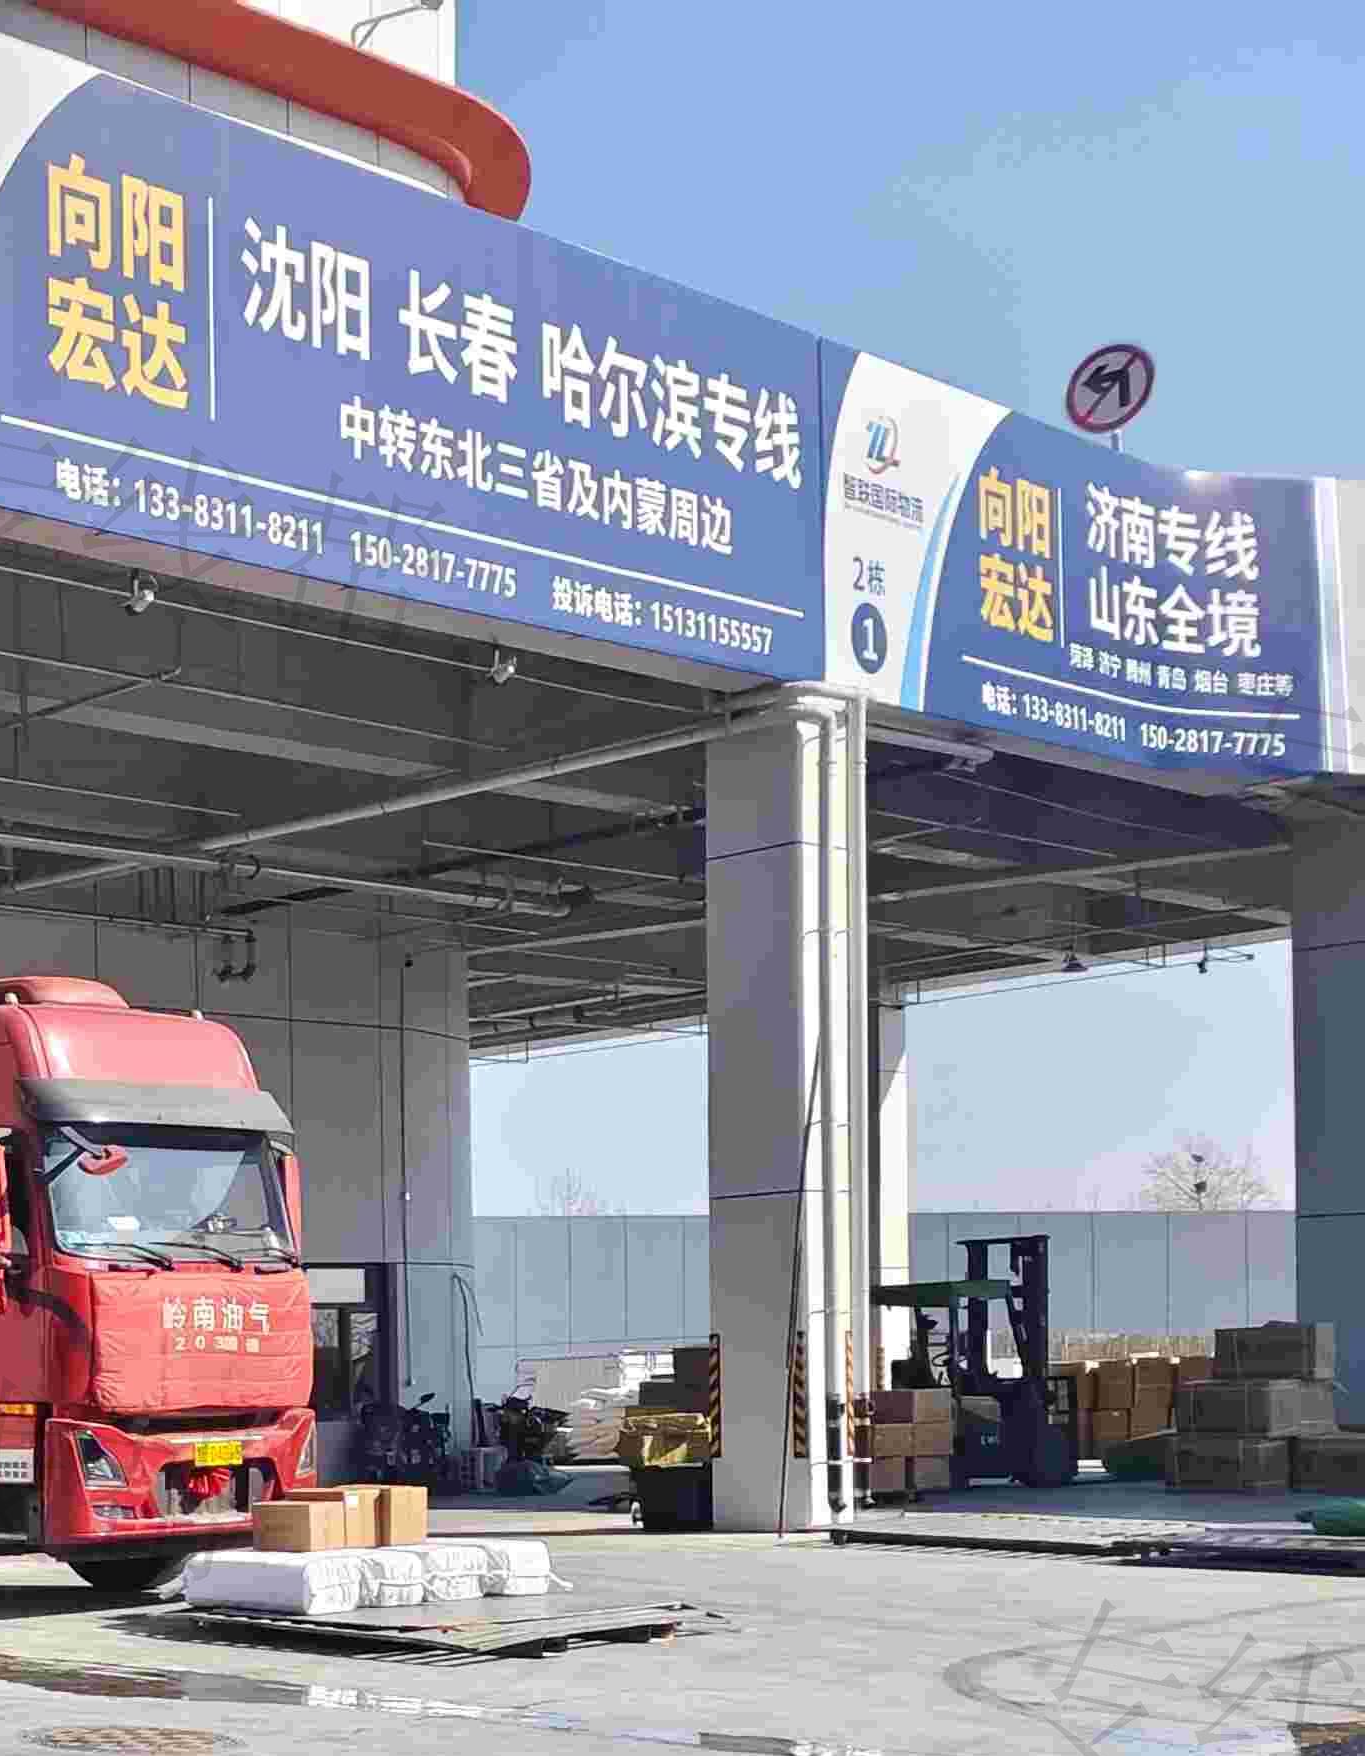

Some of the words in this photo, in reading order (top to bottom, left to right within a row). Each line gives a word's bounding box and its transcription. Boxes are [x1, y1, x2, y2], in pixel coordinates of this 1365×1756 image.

[46, 153, 187, 293] 向阳
[46, 275, 189, 410] 宏达
[241, 216, 371, 361] 沈阳
[399, 268, 518, 404] 长春
[542, 321, 803, 489] 哈尔滨专线
[340, 395, 734, 556] 中转东北三省及内蒙周边
[979, 465, 1052, 560] 向阳
[349, 530, 517, 598] 150-2817-7775
[1086, 481, 1260, 581] 济南专线
[862, 617, 878, 661] 1
[980, 553, 1054, 642] 宏达
[1088, 565, 1262, 658] 山东全境
[1141, 722, 1286, 756] 150-2817-7775
